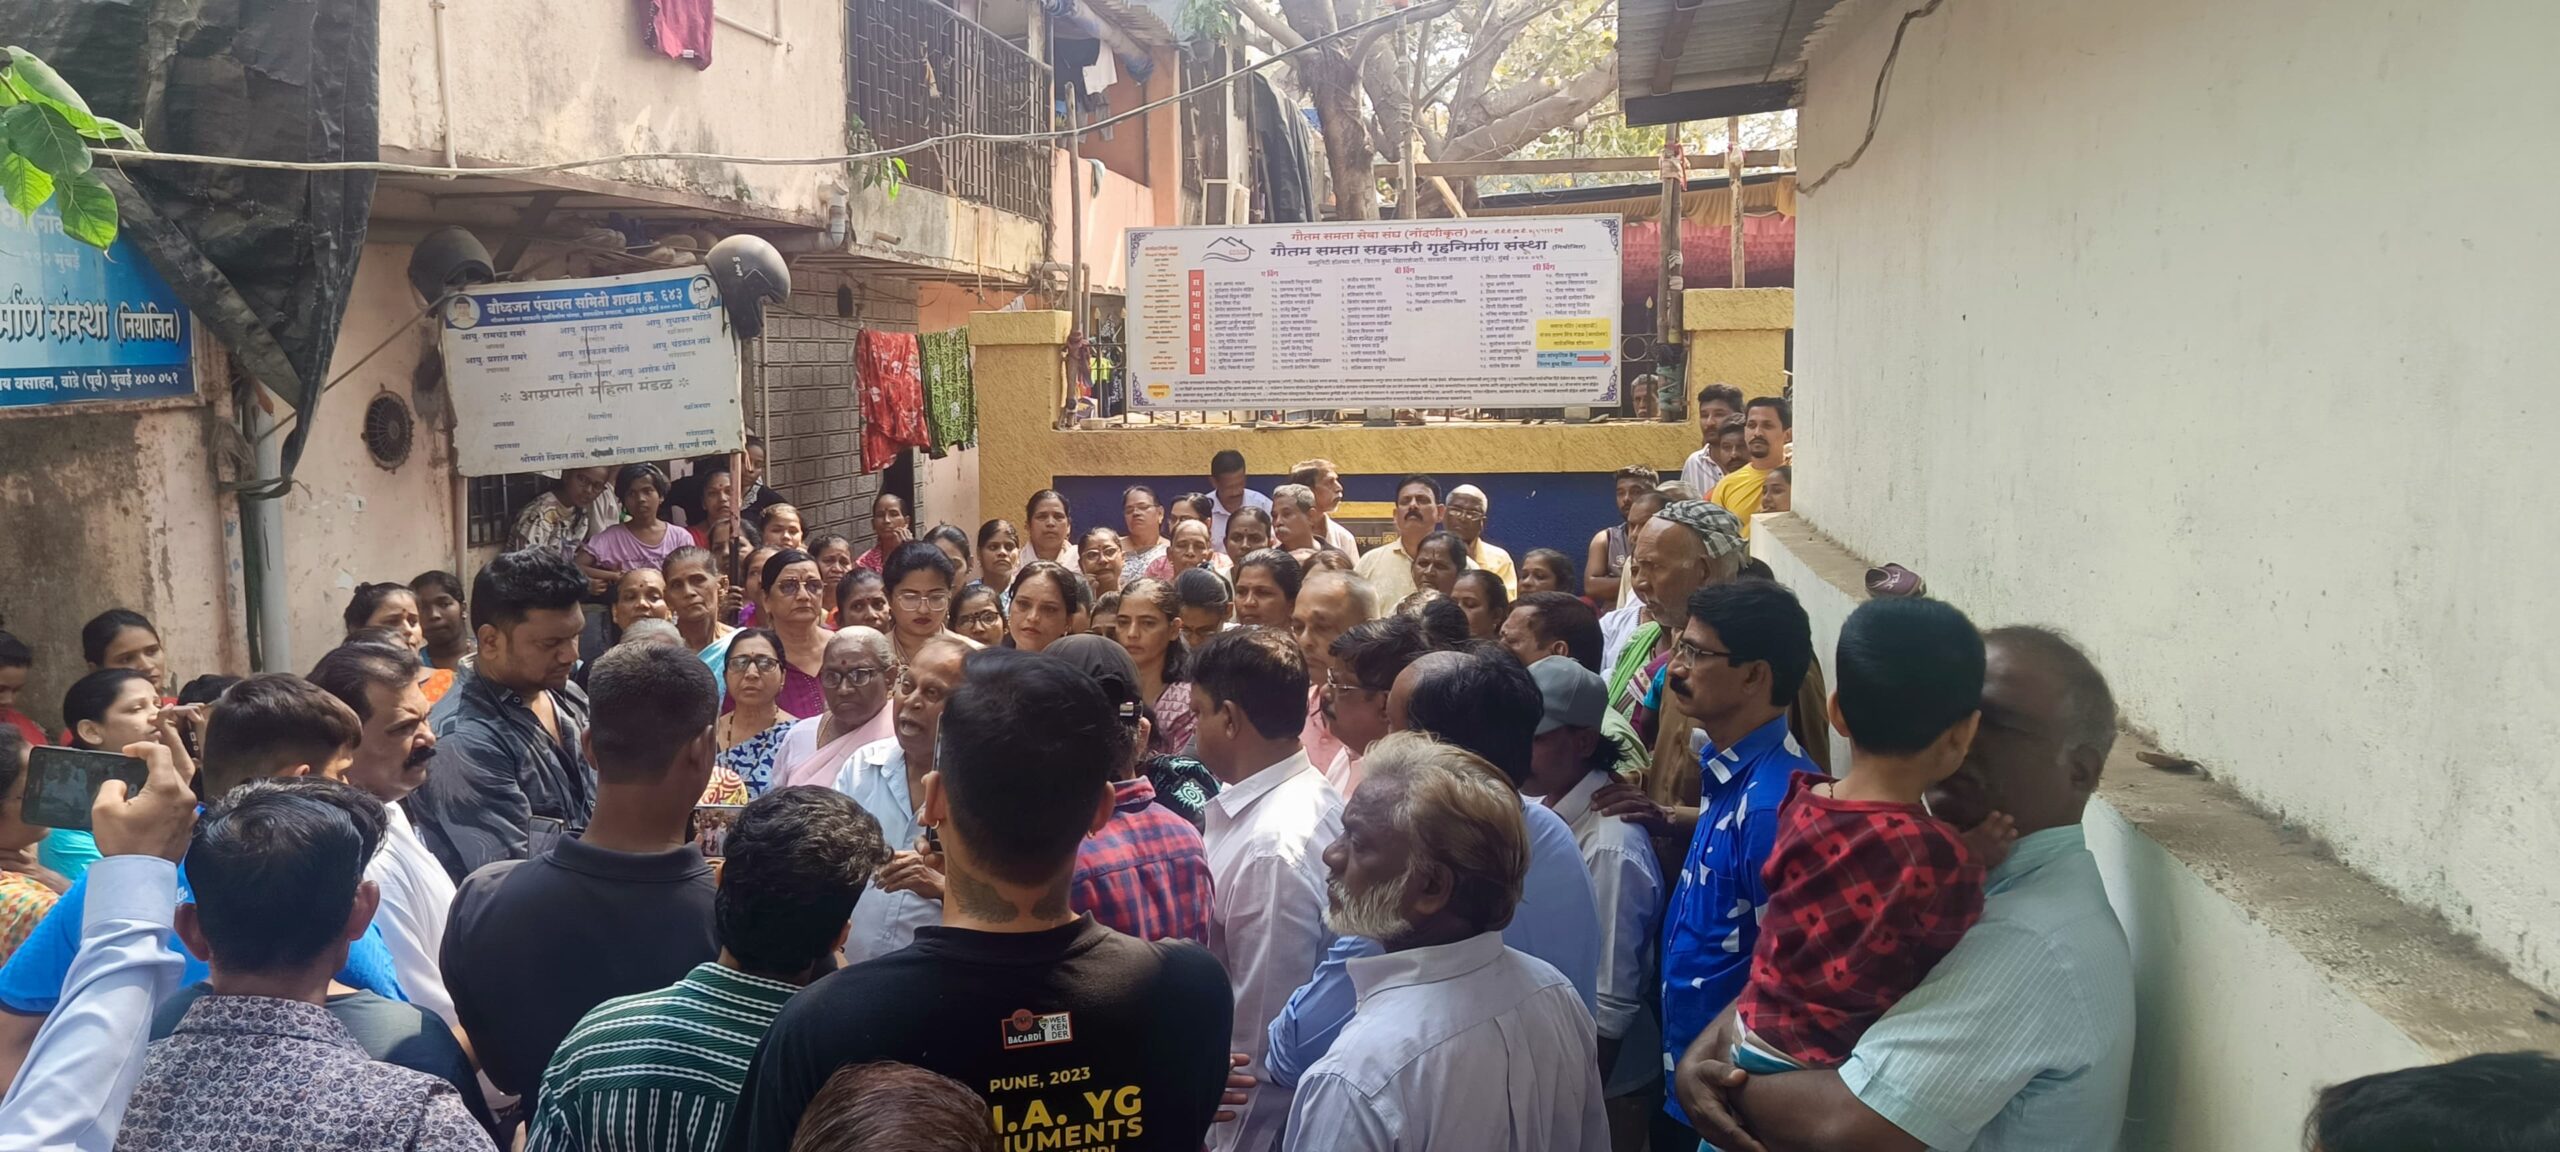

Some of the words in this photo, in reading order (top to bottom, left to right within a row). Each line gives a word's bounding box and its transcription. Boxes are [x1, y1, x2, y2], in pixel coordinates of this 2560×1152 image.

[1291, 229, 1320, 242] गौतम
[1323, 231, 1354, 241] समता
[1357, 229, 1379, 240] सेवा
[1382, 227, 1401, 239] संघ
[1270, 242, 1311, 257] गौतम
[1315, 244, 1359, 256] समता
[1363, 241, 1422, 256] सहकारी
[1427, 238, 1500, 257] गृहनिर्माण
[1504, 236, 1549, 253] संस्था
[54, 248, 81, 275] मुंबई
[534, 295, 572, 312] पंचायत
[574, 290, 609, 309] समिती
[612, 291, 642, 307] शाखा
[661, 288, 684, 302] ६४३
[48, 286, 109, 343] संस्था
[114, 300, 181, 344] (नियोजित)
[14, 376, 58, 391] वसाहत,
[61, 369, 80, 389] वांद्रे
[82, 369, 108, 392] (पूर्व)
[110, 369, 132, 391] मुंबई
[135, 374, 156, 385] ४००
[519, 382, 584, 402] आम्रपाली
[588, 380, 633, 398] महिला
[638, 377, 673, 392] मंडळ
[1049, 1014, 1067, 1024] WEE
[1051, 1023, 1068, 1032] KEN
[1051, 1031, 1070, 1040] DER
[990, 1074, 1044, 1093] PUNE,
[1049, 1066, 1091, 1085] 2023
[1083, 1085, 1142, 1120] YG
